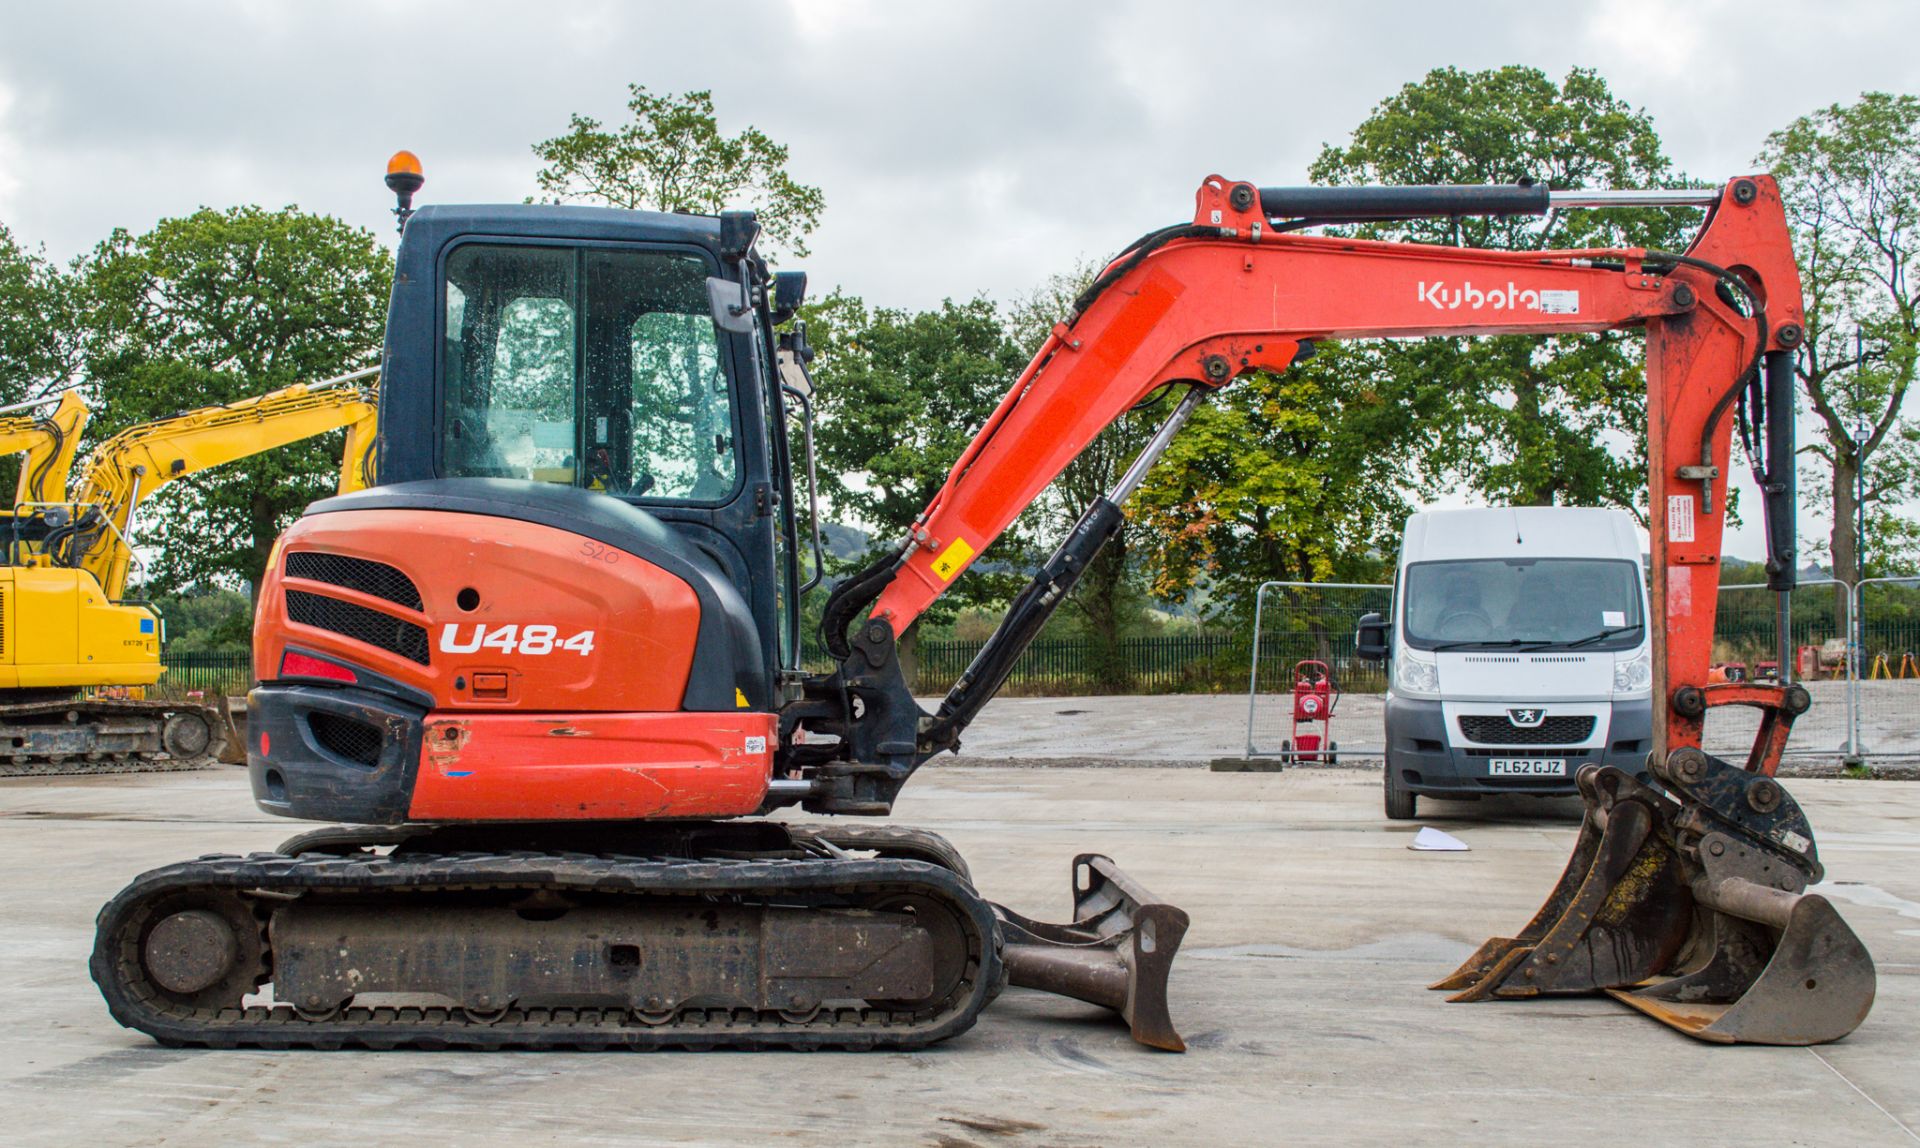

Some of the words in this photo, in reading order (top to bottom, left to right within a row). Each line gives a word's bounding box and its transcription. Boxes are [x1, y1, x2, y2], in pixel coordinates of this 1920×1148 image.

[1418, 281, 1540, 309] Kubota
[579, 541, 619, 564] S20
[439, 623, 595, 656] U48-4
[1494, 761, 1530, 773] FL62
[1533, 761, 1560, 773] GJZ
